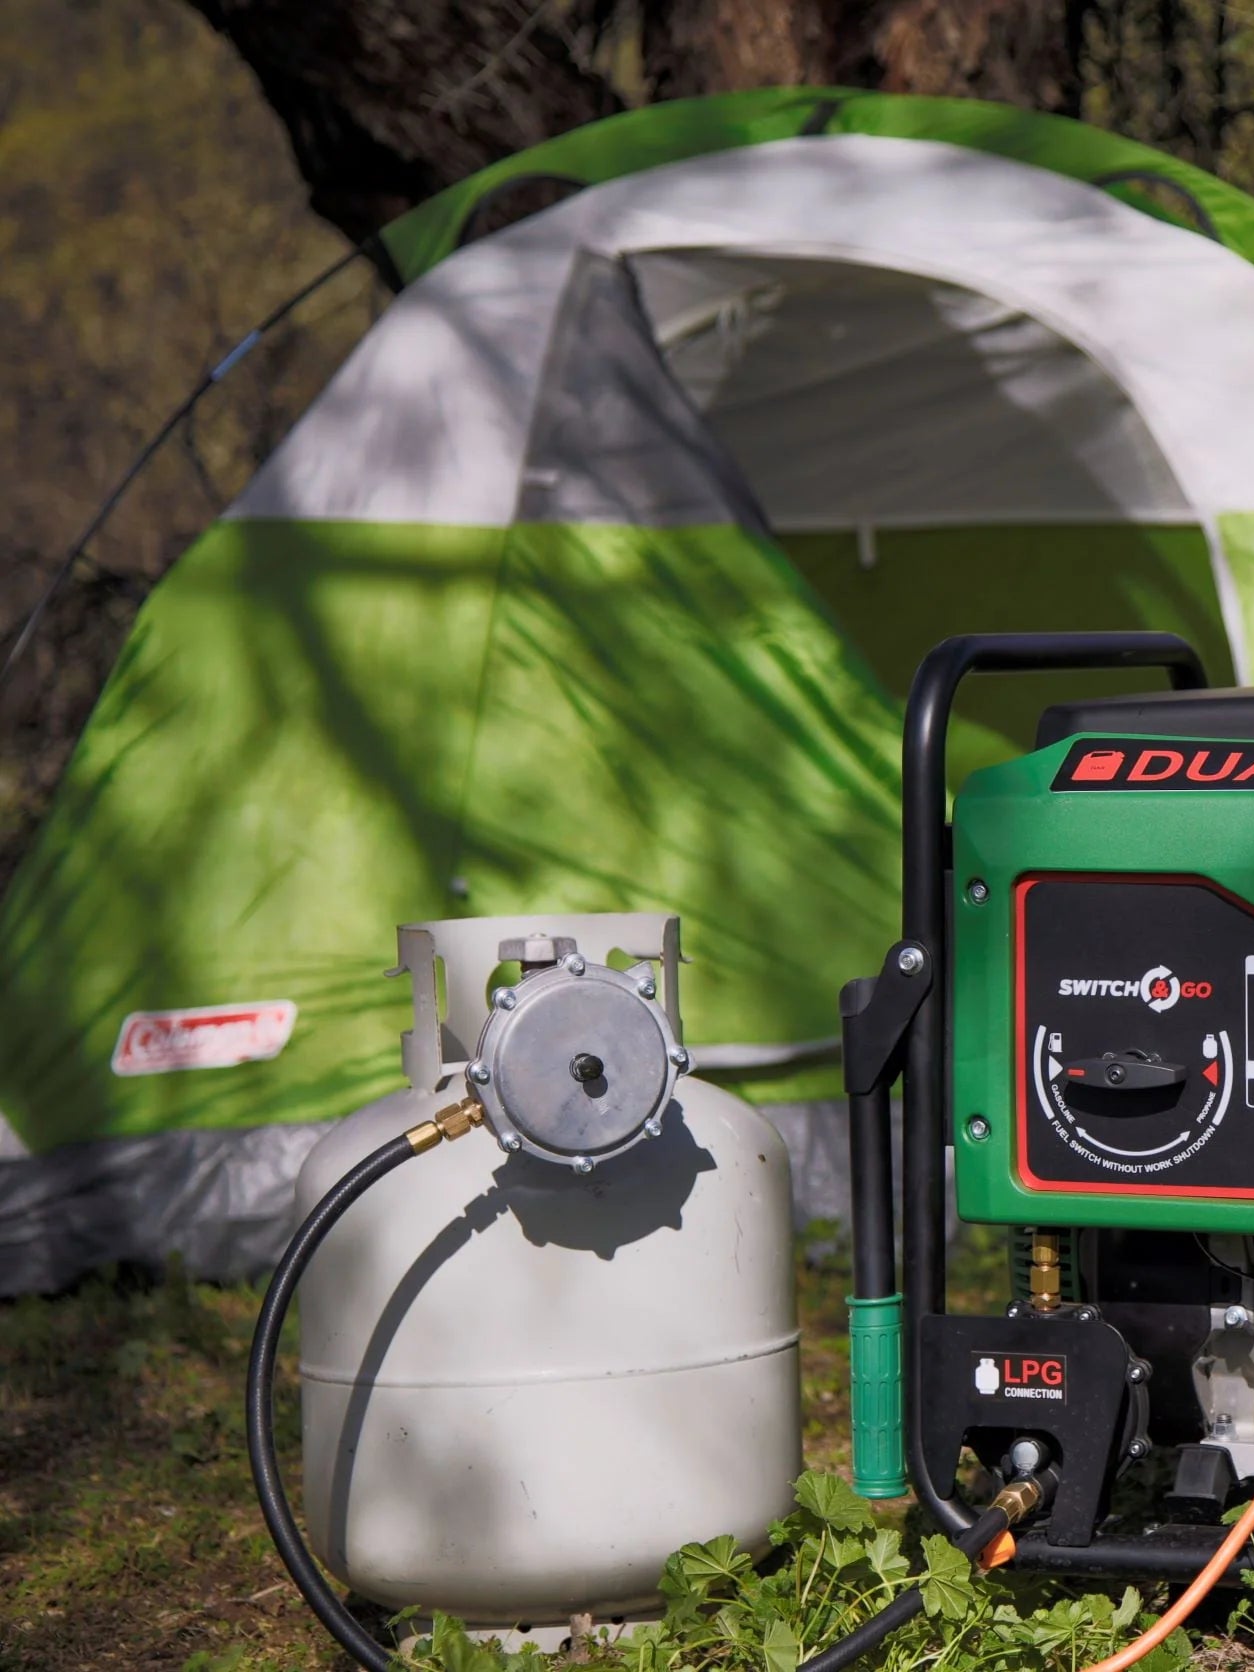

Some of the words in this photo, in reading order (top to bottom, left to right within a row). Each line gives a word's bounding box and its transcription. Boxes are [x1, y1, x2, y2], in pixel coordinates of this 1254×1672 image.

[1058, 979, 1140, 997] SWITCH
[1181, 982, 1212, 998] GO
[1051, 1084, 1076, 1124] GASOLINE
[1196, 1091, 1216, 1123] PROPANE
[1051, 1120, 1069, 1143] FUEL
[1069, 1140, 1101, 1165] SWITCH
[1100, 1158, 1148, 1174] WITHOUT
[1144, 1158, 1173, 1173] WORK
[1173, 1125, 1216, 1164] SHUTDOWN
[1004, 1359, 1063, 1385] LPG
[1004, 1387, 1063, 1400] CONNECTION
